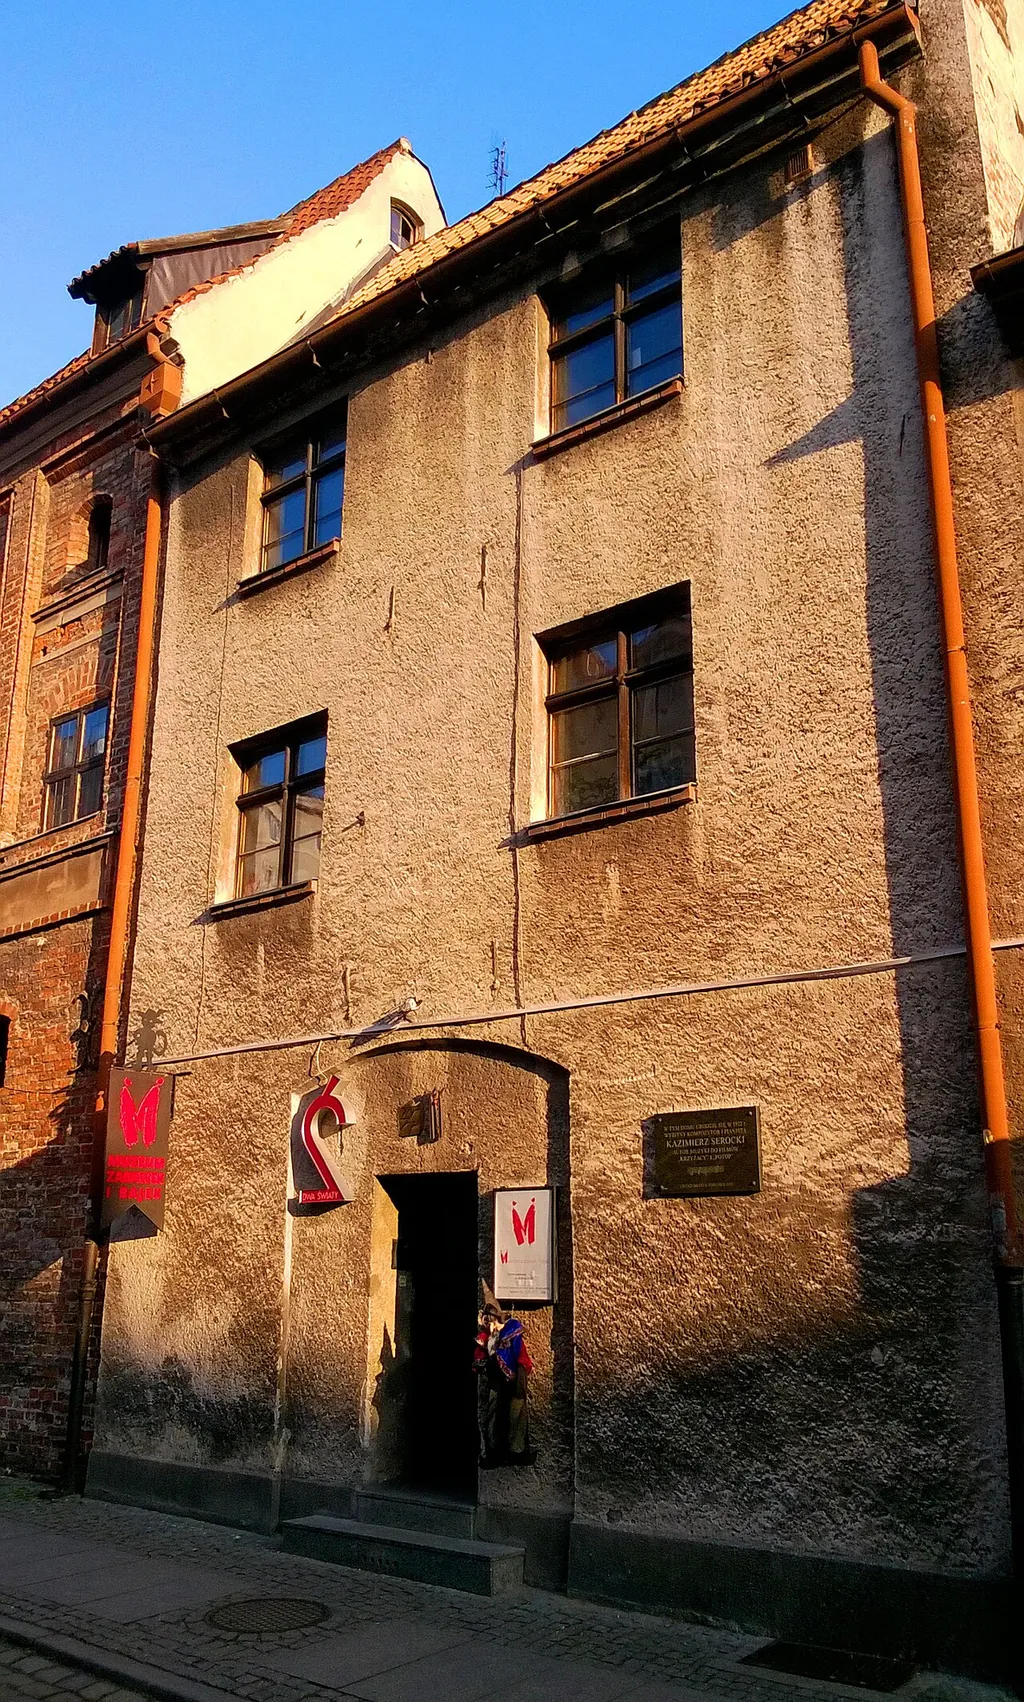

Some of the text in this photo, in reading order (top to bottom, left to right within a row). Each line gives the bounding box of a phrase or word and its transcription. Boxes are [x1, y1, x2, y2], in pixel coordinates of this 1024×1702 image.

[666, 1135, 745, 1148] KAZIMIERZ SEROCKI
[302, 1190, 339, 1201] DWA ŚWIATY
